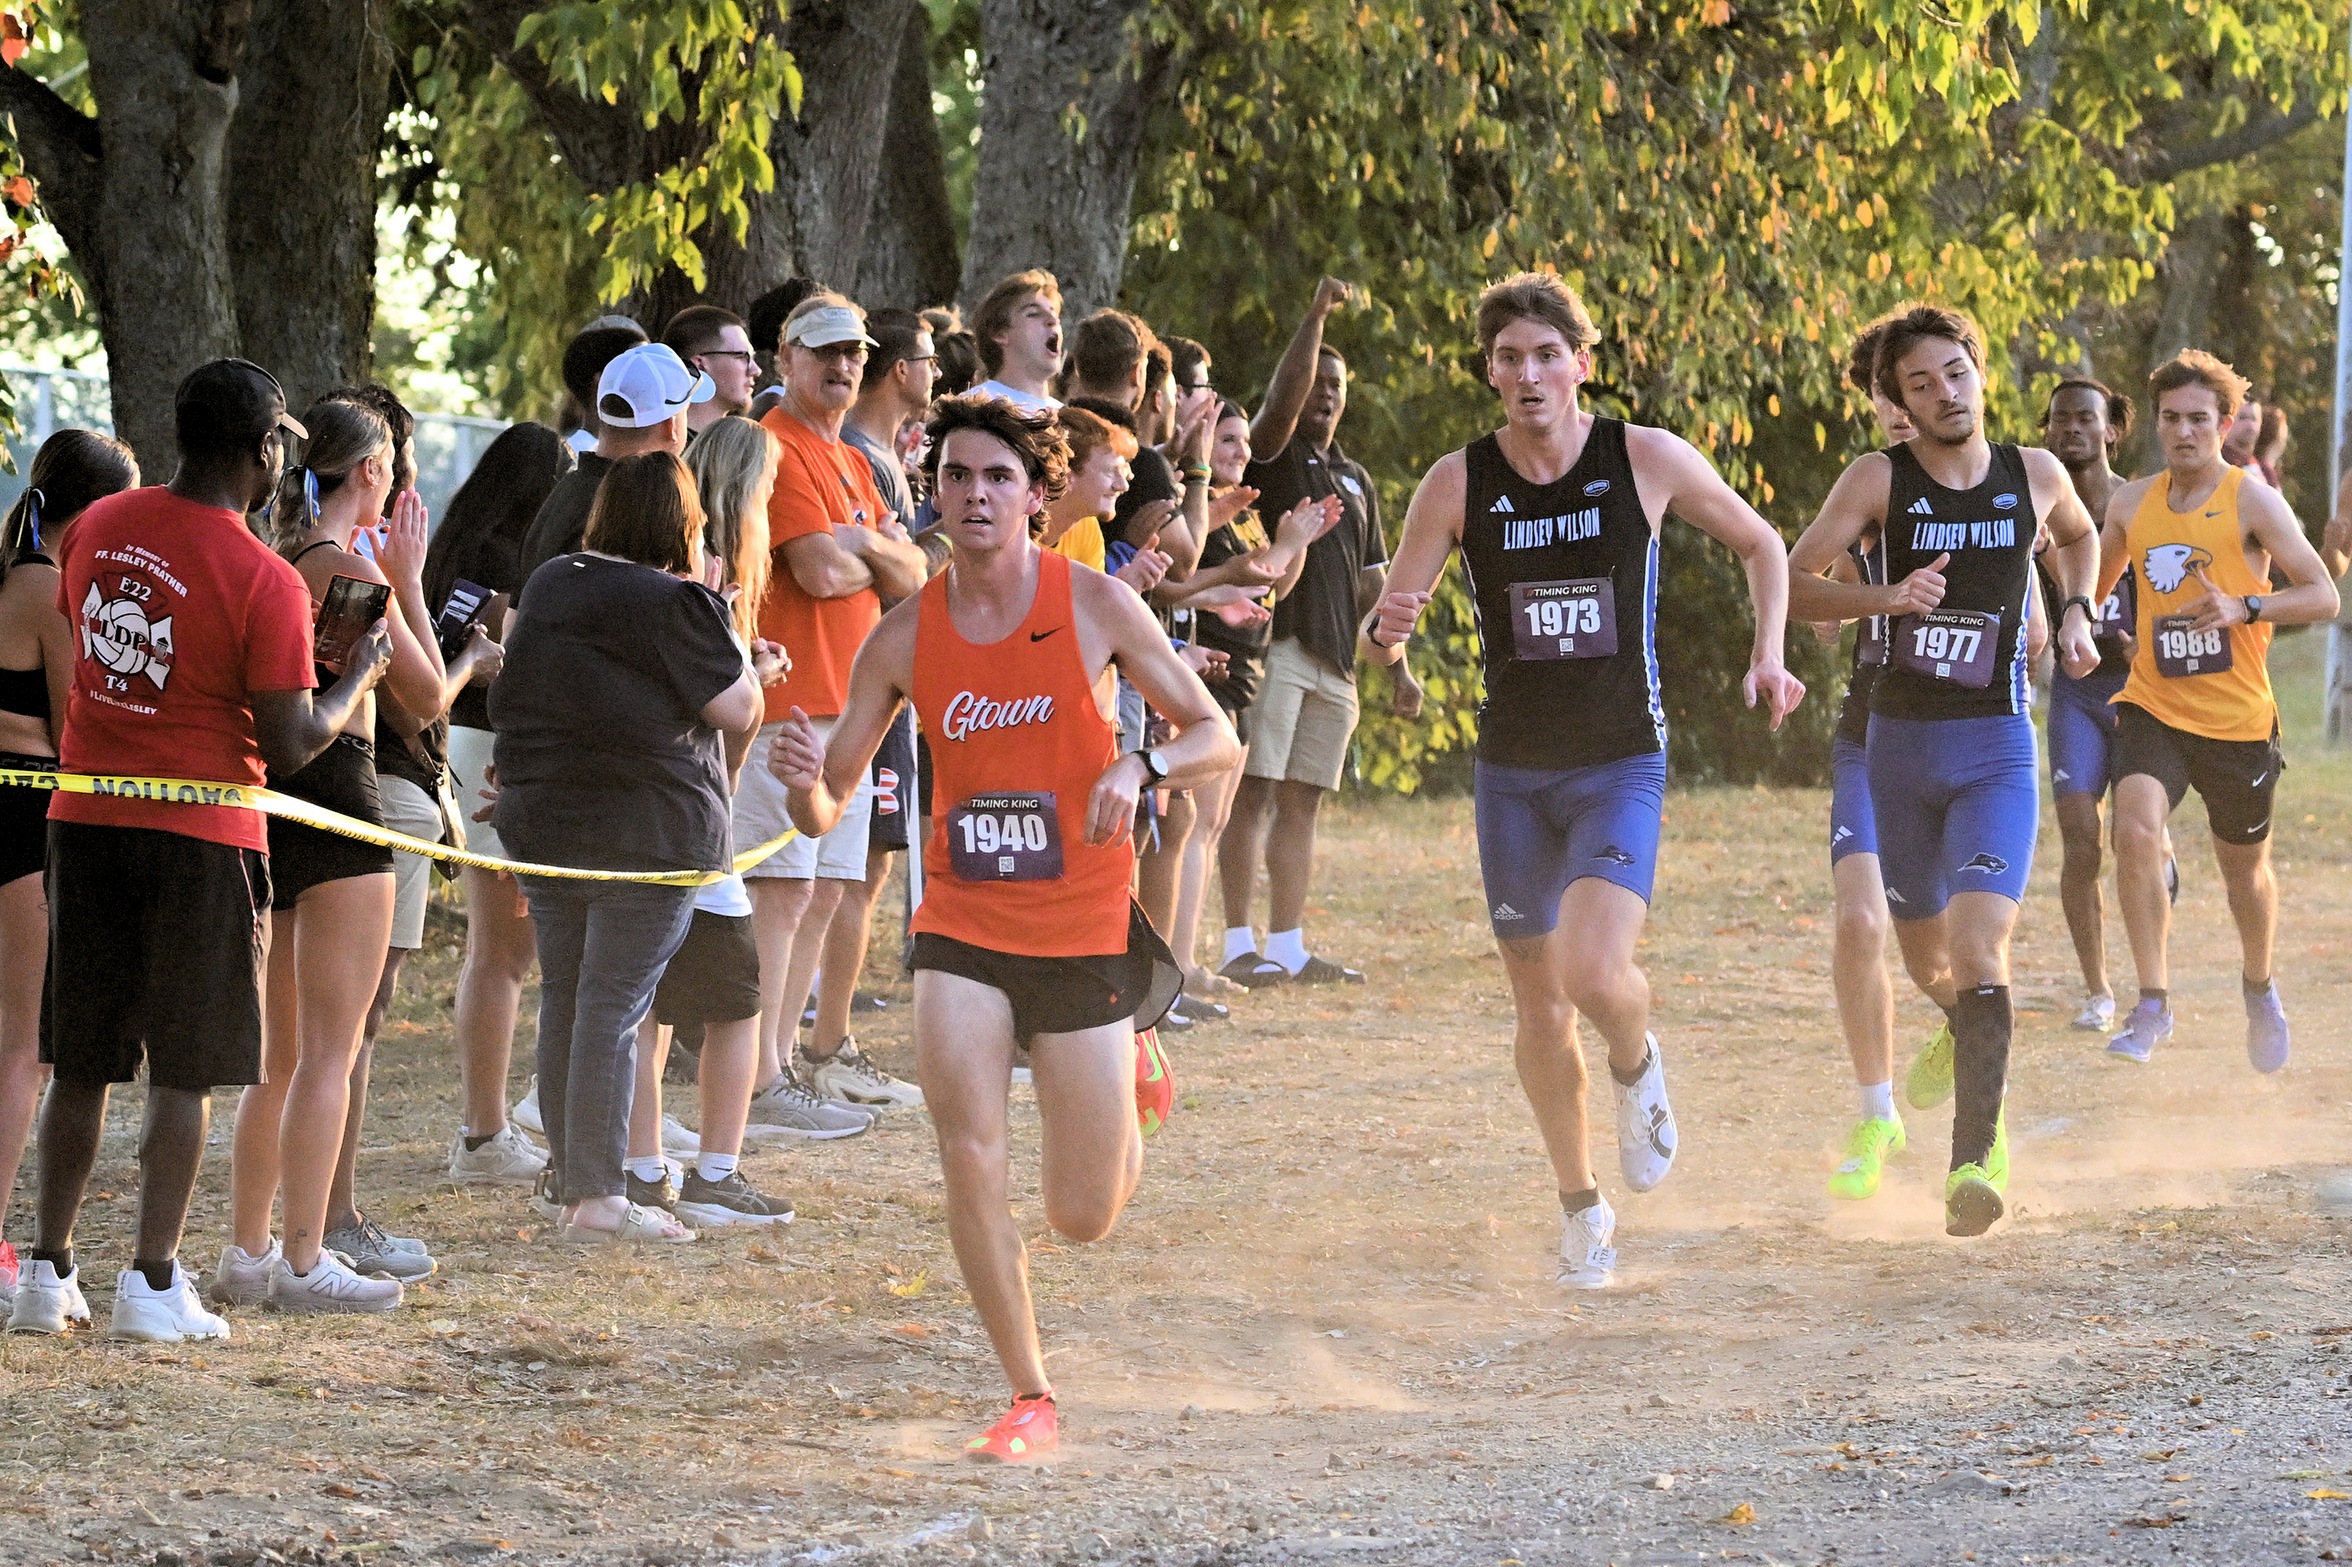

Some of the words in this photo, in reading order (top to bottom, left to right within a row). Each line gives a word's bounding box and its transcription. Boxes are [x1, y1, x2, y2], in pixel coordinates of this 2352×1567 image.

[1503, 517, 1553, 550] LINDSEY
[1556, 506, 1600, 542] WILSON
[1911, 522, 1967, 550] LINDSEY
[1970, 518, 2015, 549] WILSON
[111, 551, 147, 568] LESLEY
[147, 563, 188, 598] PRATHER
[118, 576, 152, 601] E22
[1534, 587, 1570, 597] TIMING
[1572, 584, 1597, 594] KING
[1524, 598, 1600, 636] 1973
[1959, 616, 1984, 626] KING
[99, 619, 147, 651] LDP
[1913, 626, 1982, 663] 1977
[2159, 628, 2222, 659] 1988
[104, 675, 128, 692] T4
[942, 690, 1055, 741] Gtown
[971, 799, 1009, 809] TIMING
[1011, 799, 1038, 809] KING
[957, 813, 1048, 853] 1940
